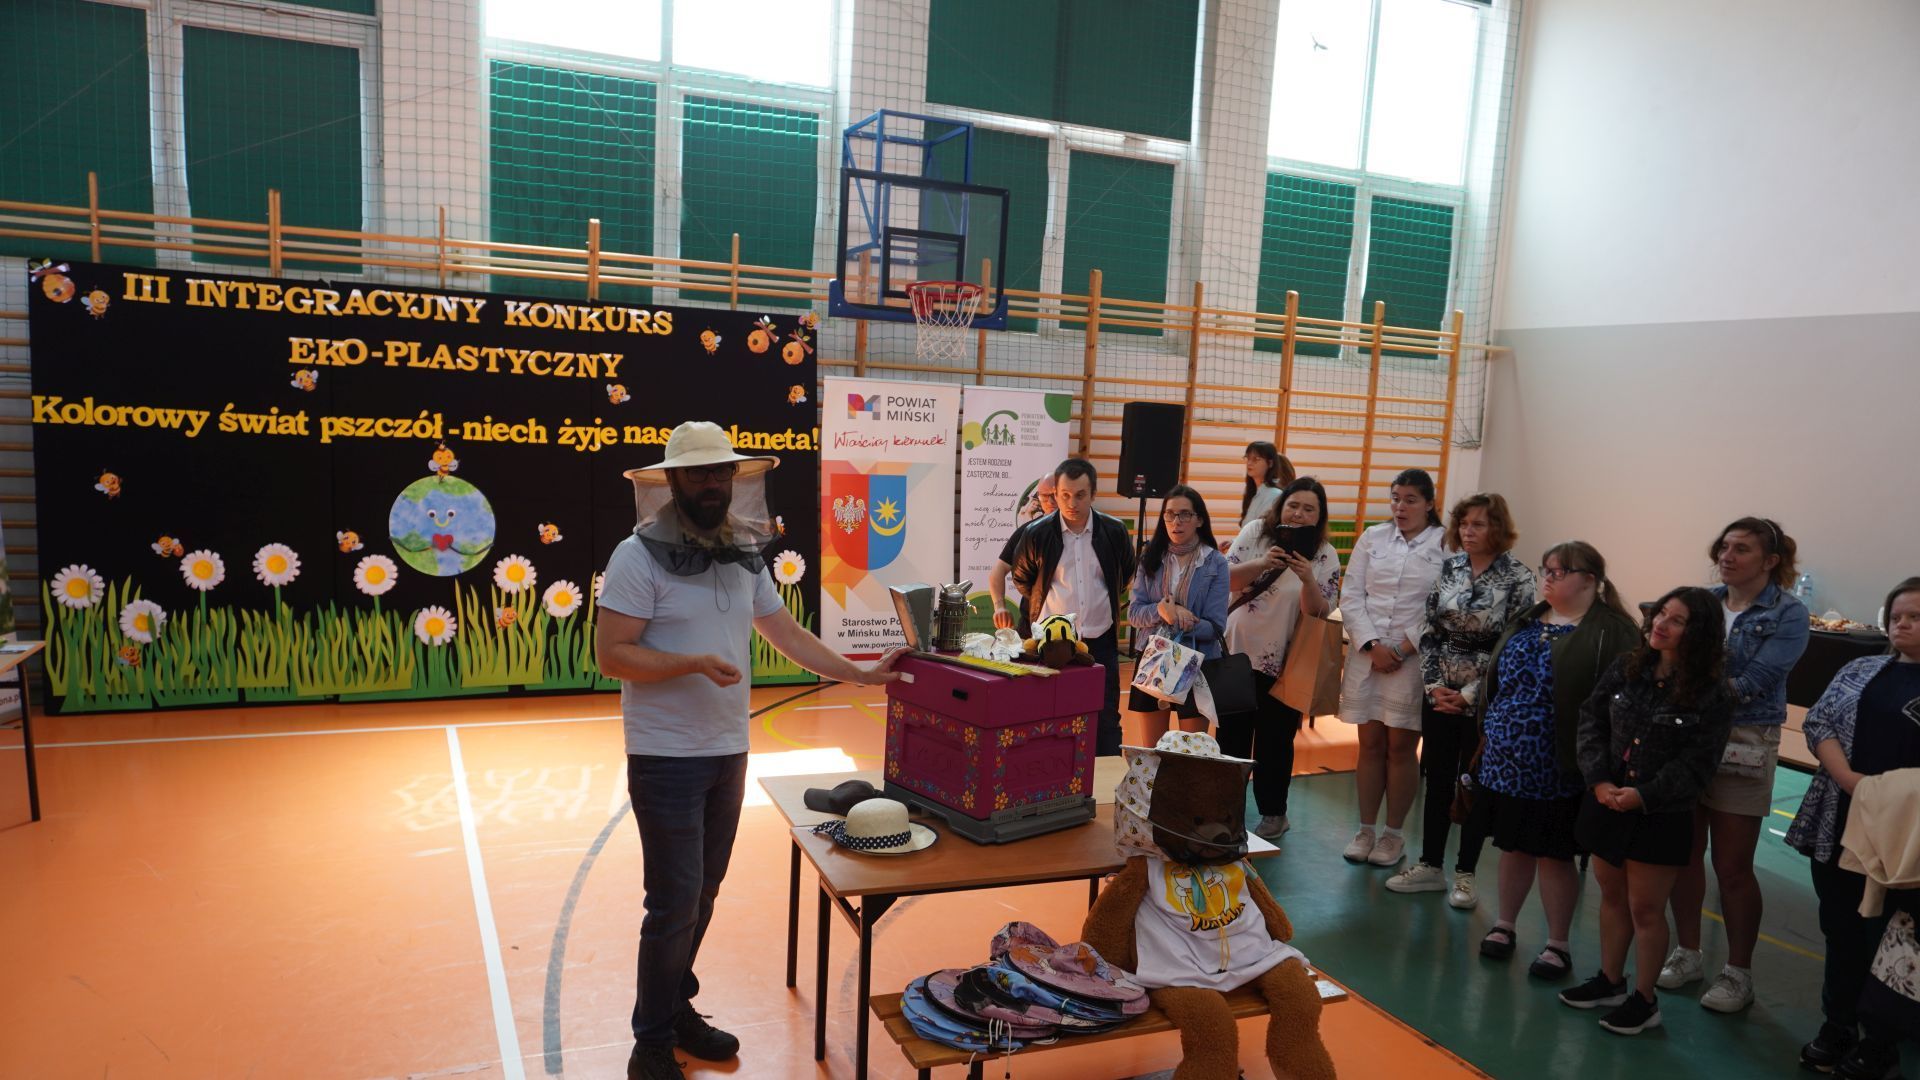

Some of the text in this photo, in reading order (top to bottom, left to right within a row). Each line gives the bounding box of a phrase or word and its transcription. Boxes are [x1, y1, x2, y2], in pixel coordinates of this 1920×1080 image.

[122, 272, 673, 336] III INTEGRACYJNY KONKURS
[288, 336, 624, 379] EKO-PLASTYCZNY
[887, 396, 937, 409] POWIAT
[887, 408, 935, 423] MIŃSKI
[31, 395, 211, 438] Kolorowy
[218, 403, 310, 436] świat
[319, 409, 443, 444] pszczół
[557, 417, 618, 452] żyje
[623, 424, 673, 446] nas
[724, 424, 819, 451] laneta!
[967, 457, 1012, 467] JESTEM RODZICEM
[842, 617, 888, 627] Starostwo
[847, 628, 880, 638] Mińsku
